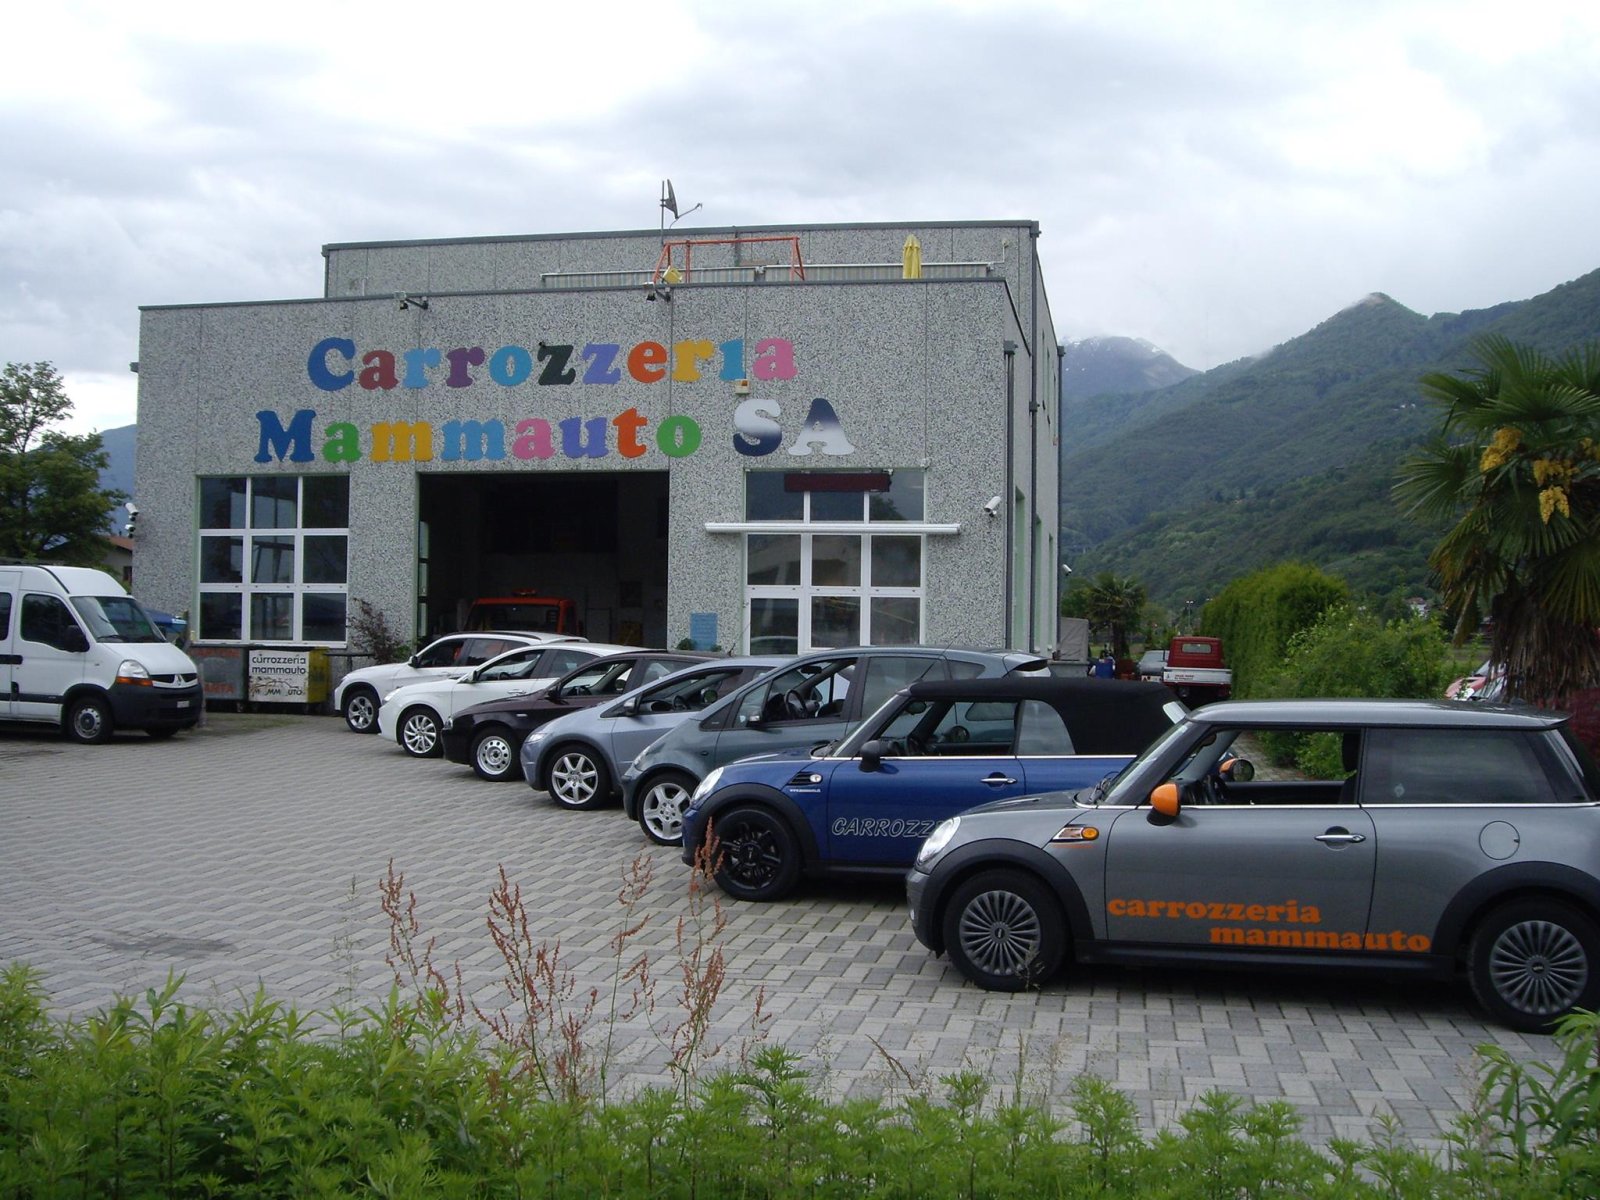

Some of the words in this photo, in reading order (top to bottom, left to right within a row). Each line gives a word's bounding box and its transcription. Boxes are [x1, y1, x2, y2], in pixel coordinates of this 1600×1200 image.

[307, 336, 797, 391] Carrozzeria
[253, 407, 701, 463] Mammauto
[733, 397, 855, 457] SA
[251, 666, 307, 674] mammauto
[1107, 898, 1321, 924] carrozzeria
[1210, 926, 1431, 952] mammauto
